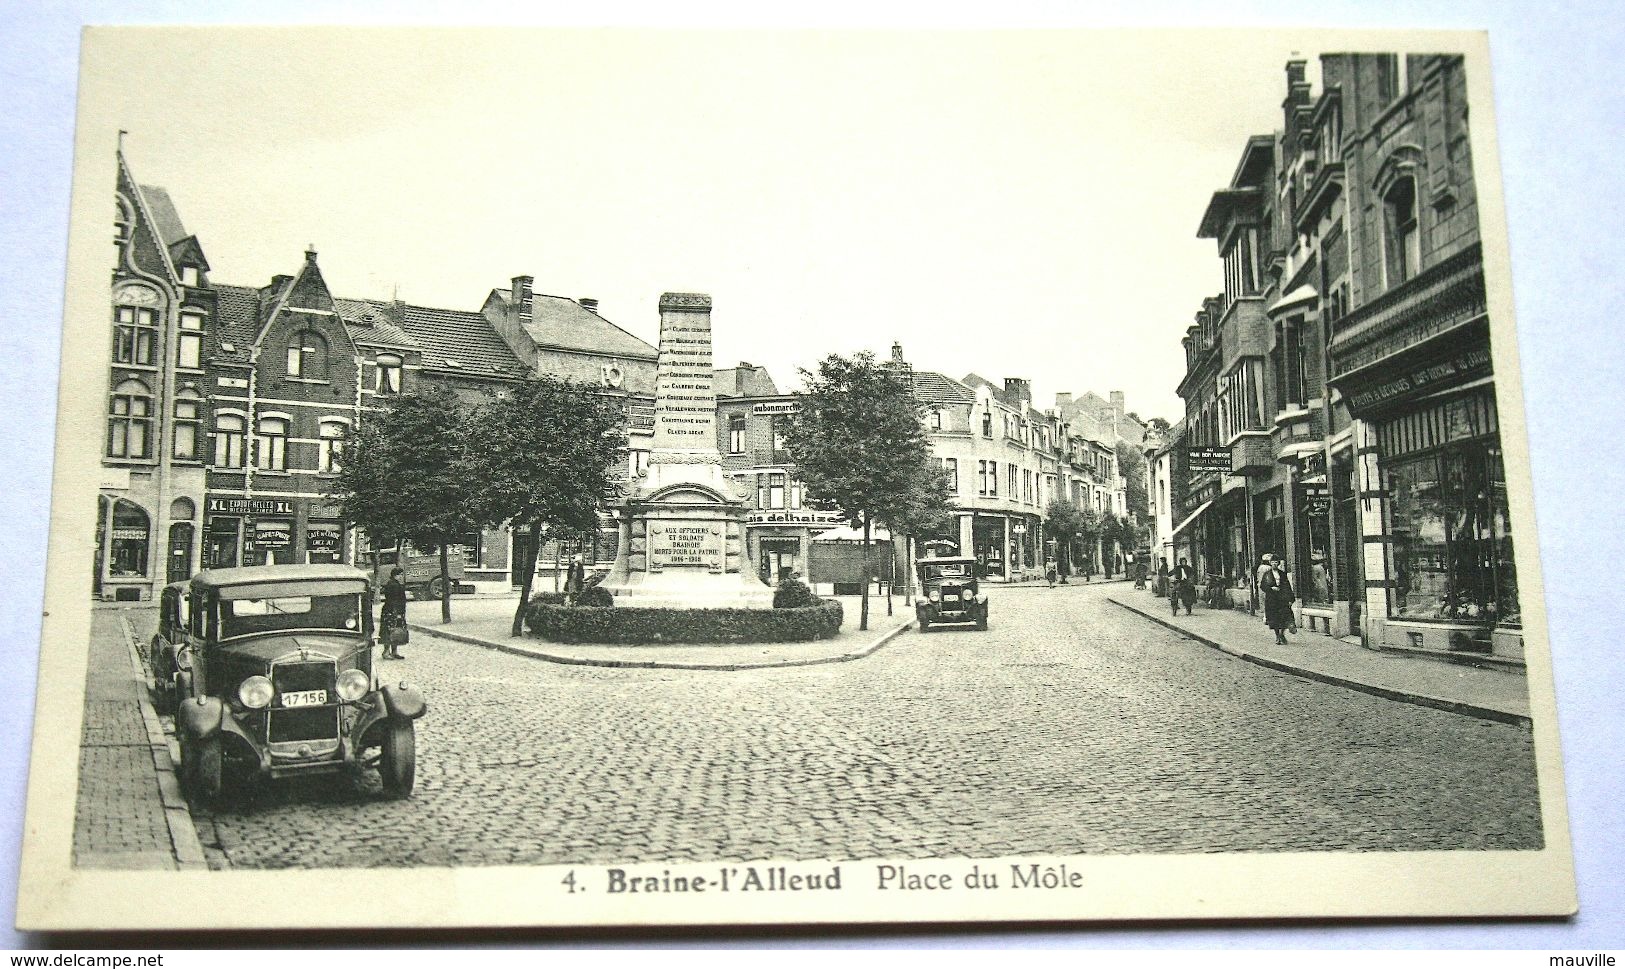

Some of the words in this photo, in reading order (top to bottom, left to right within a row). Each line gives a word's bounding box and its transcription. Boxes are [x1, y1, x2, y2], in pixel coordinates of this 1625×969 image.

[210, 500, 227, 511] XL
[276, 502, 293, 513] XL
[562, 872, 585, 893] 4.
[607, 866, 841, 893] Braine-l'Alleud
[877, 865, 952, 890] Place
[965, 865, 999, 889] du
[1011, 865, 1083, 889] Môle
